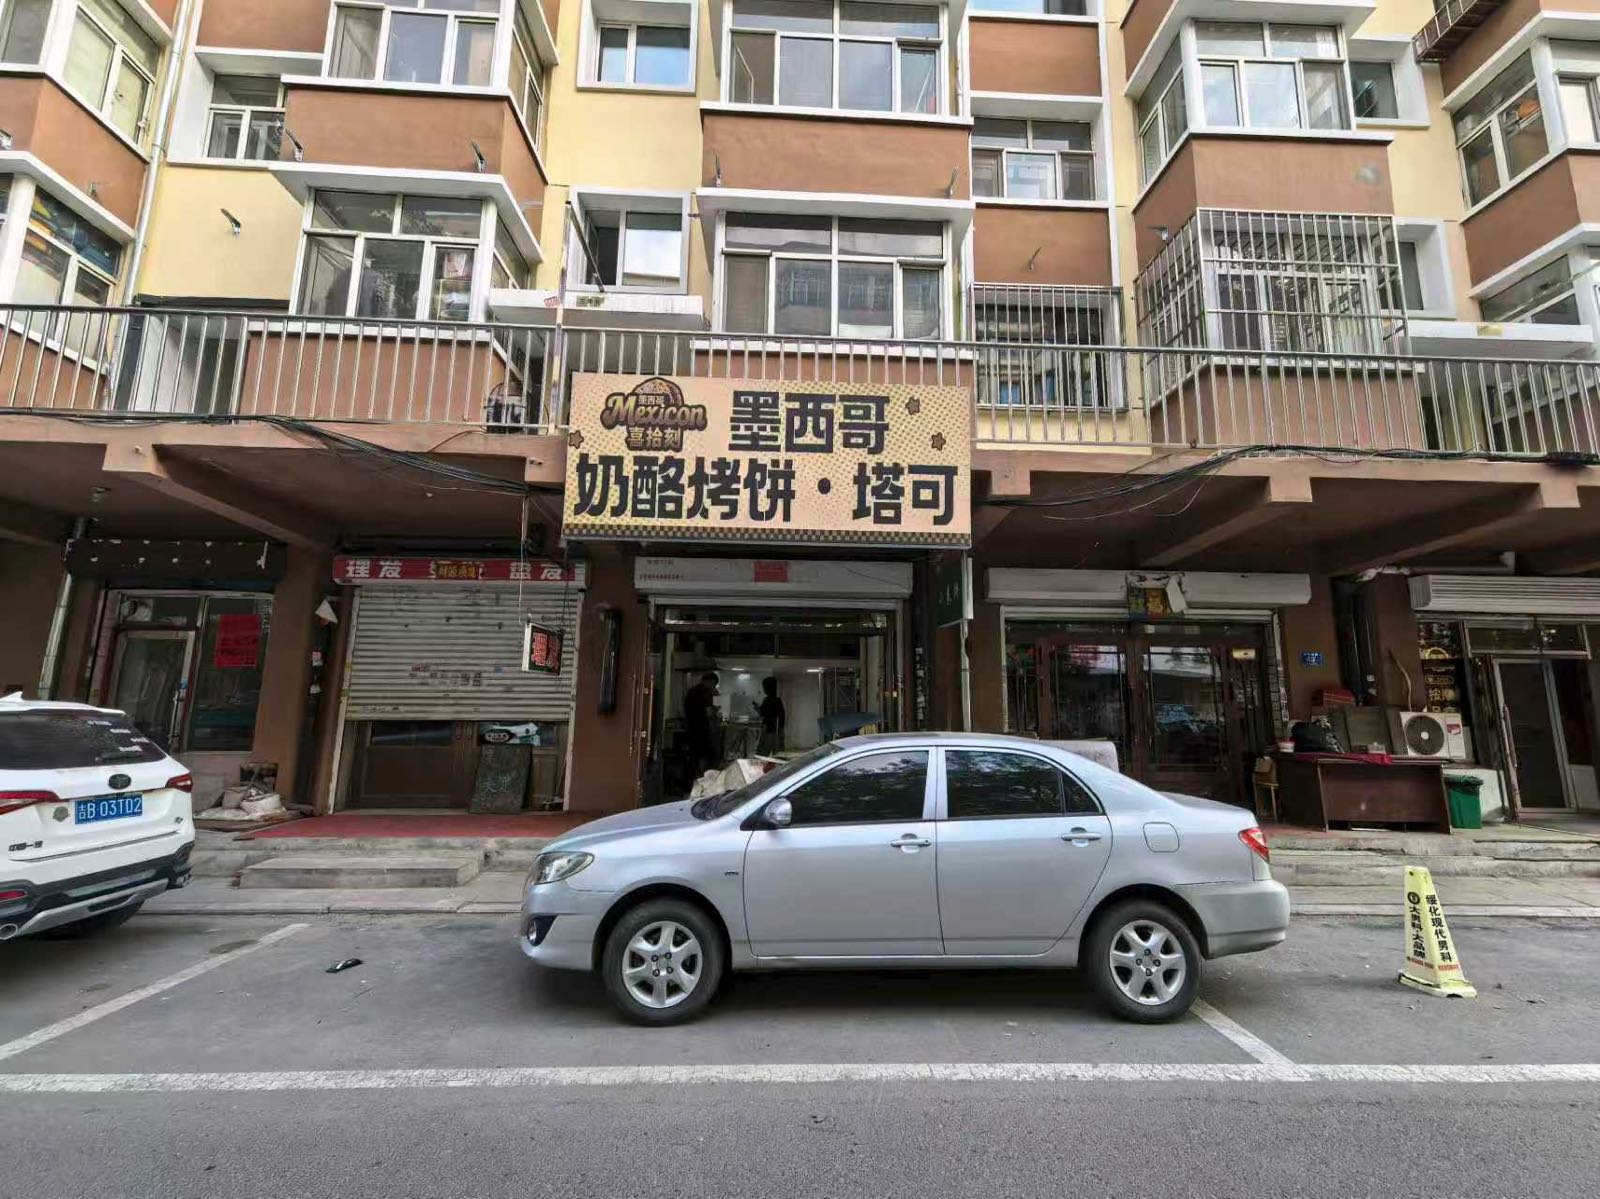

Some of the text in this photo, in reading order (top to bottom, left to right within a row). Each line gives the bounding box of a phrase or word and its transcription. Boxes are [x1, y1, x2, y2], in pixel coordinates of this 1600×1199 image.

[601, 393, 707, 428] Mexicon
[728, 390, 890, 455] 墨西哥
